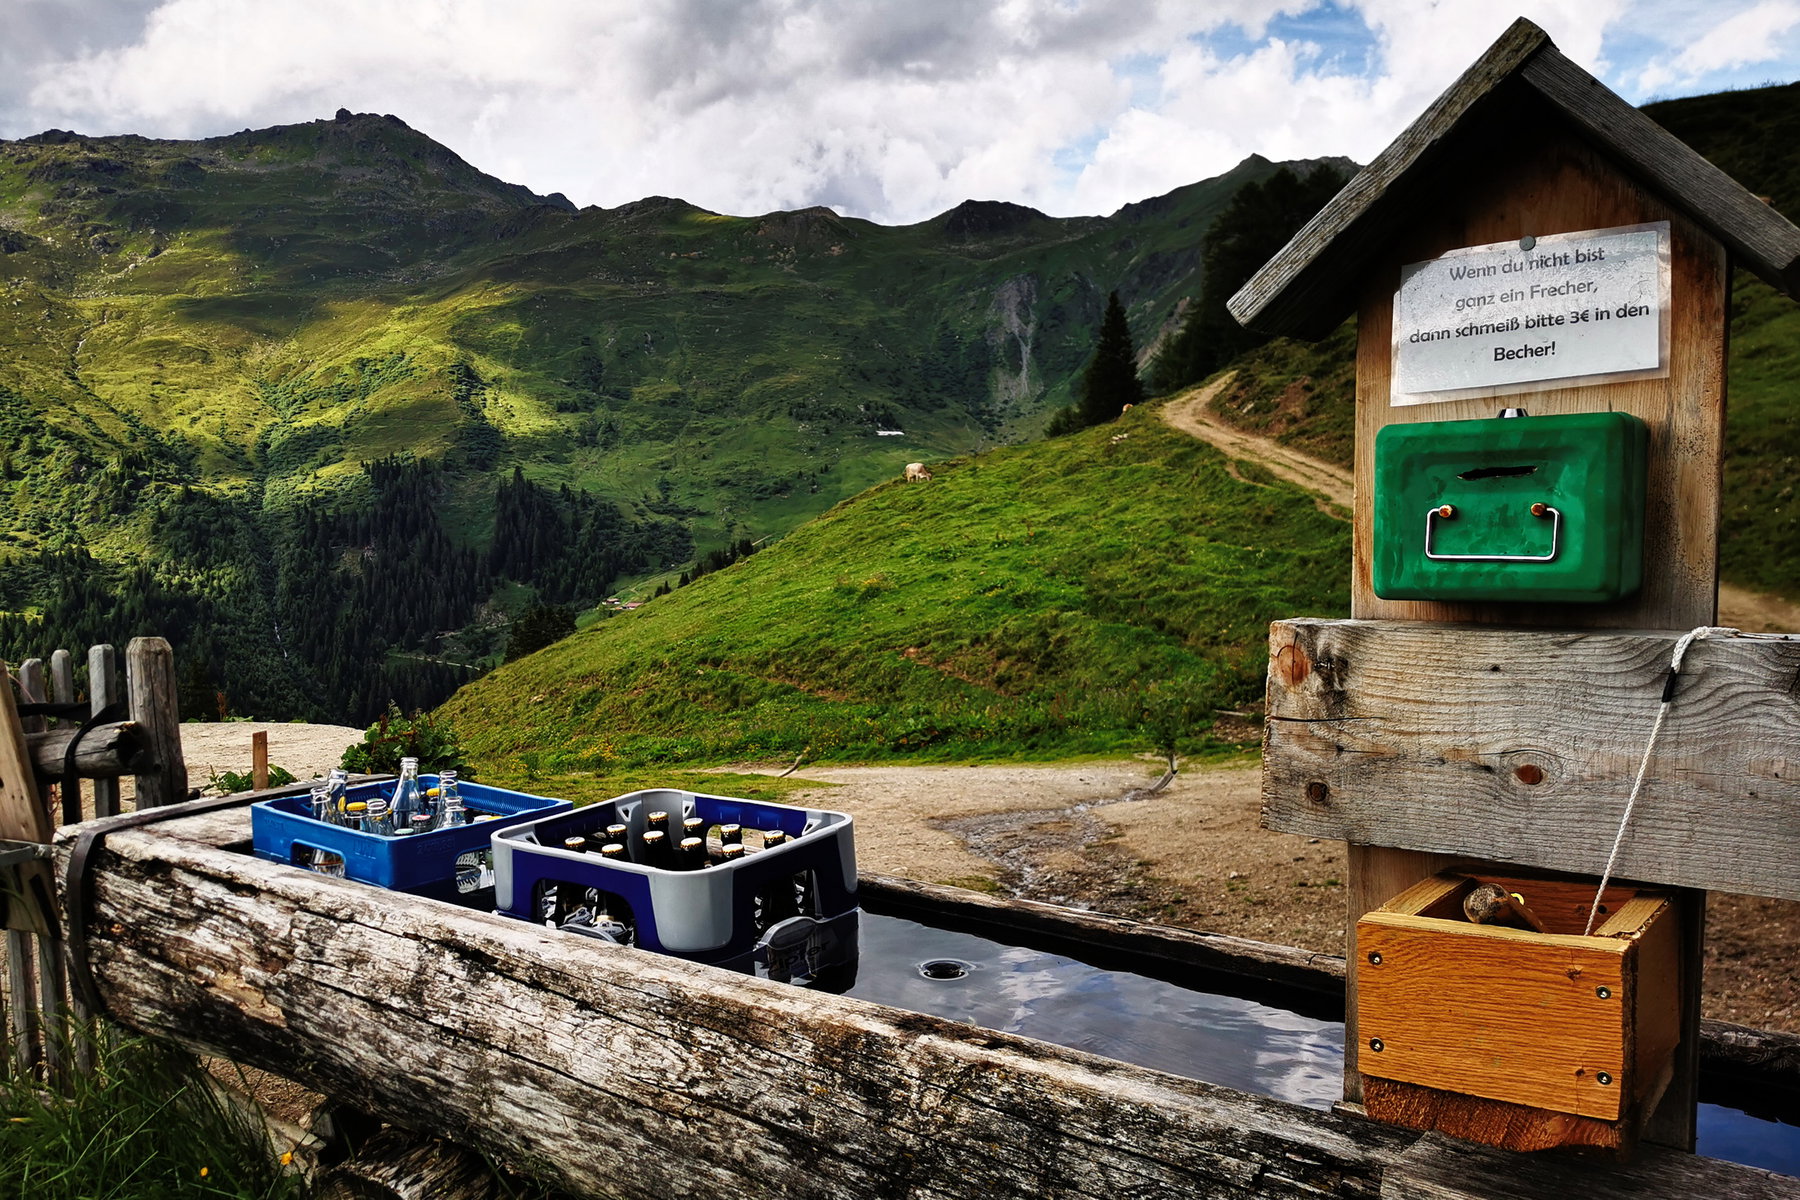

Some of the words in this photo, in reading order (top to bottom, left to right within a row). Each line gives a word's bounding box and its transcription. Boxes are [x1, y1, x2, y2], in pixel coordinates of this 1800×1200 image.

[1450, 264, 1497, 281] Wenn
[1501, 259, 1524, 274] du
[1528, 252, 1570, 271] nicht
[1575, 247, 1606, 264] bist
[1455, 292, 1496, 312] ganz
[1500, 288, 1525, 304] ein
[1530, 279, 1599, 300] Frecher,
[1409, 326, 1451, 344] dann
[1455, 316, 1519, 338] schmeiß
[1525, 311, 1566, 330] bitte
[1569, 308, 1590, 325] 3€
[1594, 305, 1611, 321] in
[1615, 303, 1651, 320] den
[1493, 341, 1557, 362] Becher!
